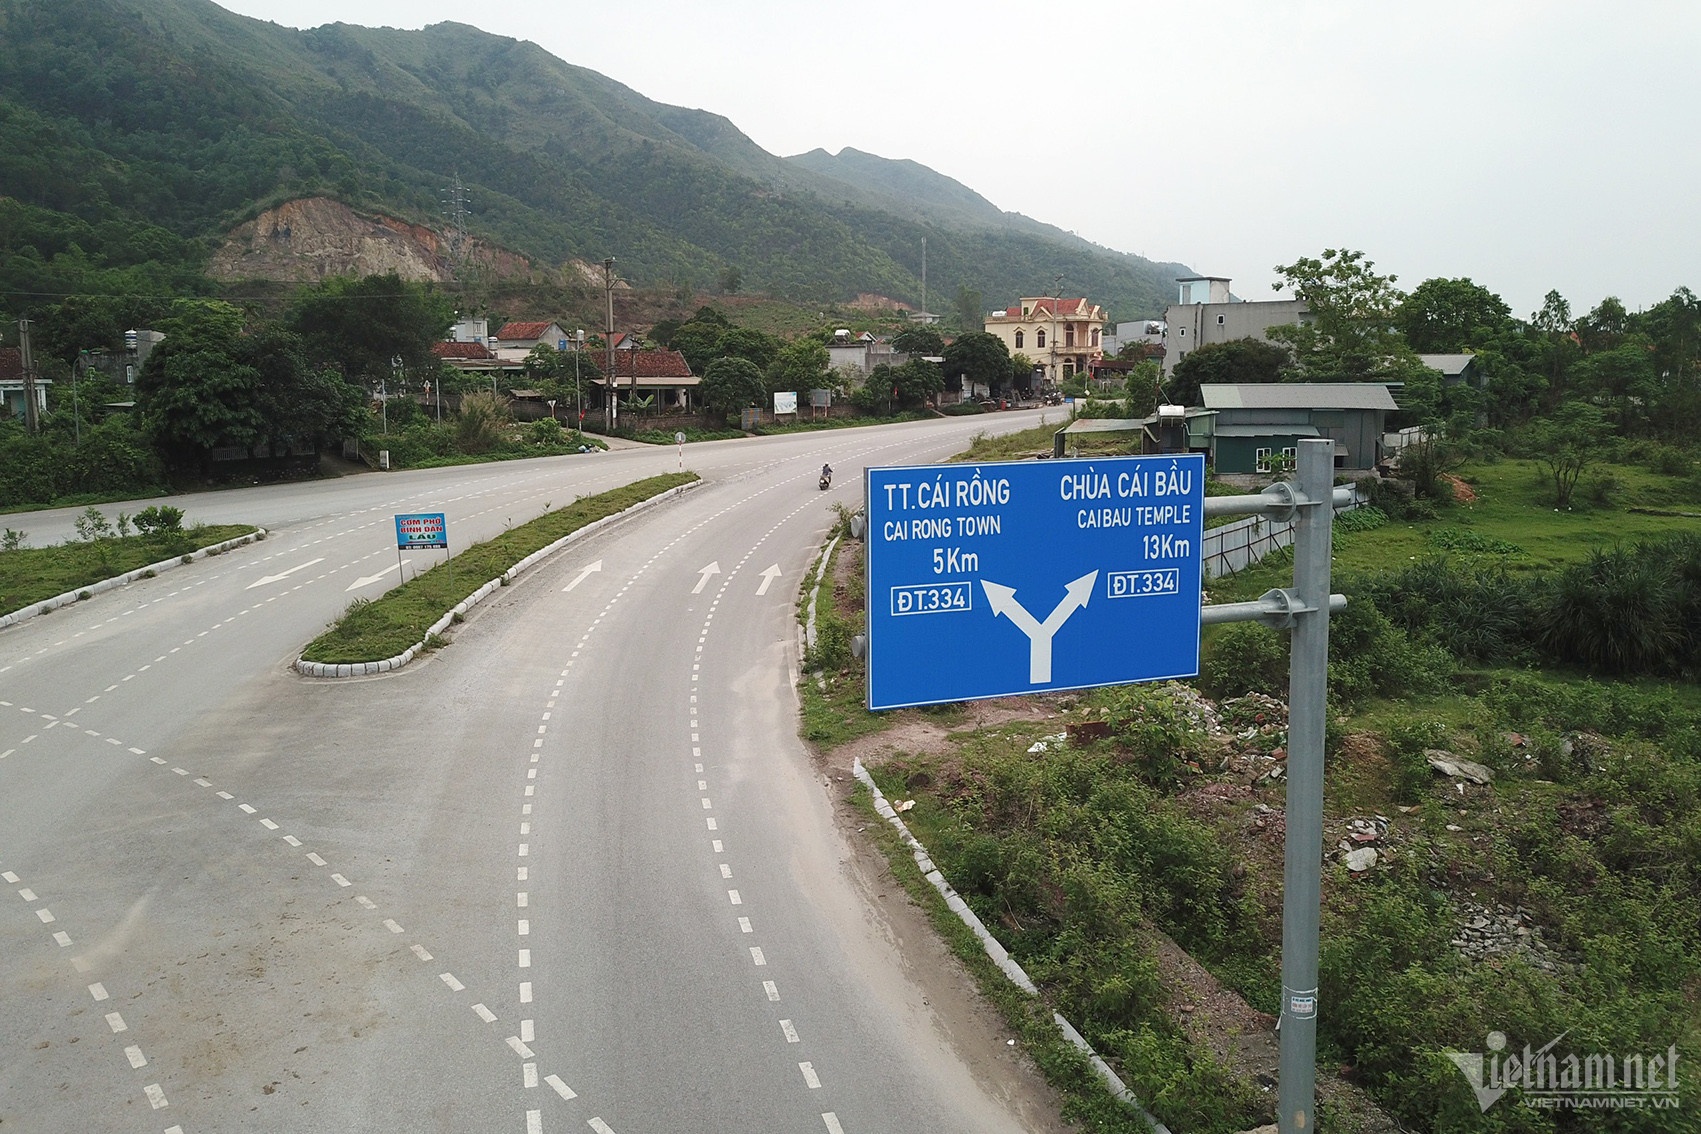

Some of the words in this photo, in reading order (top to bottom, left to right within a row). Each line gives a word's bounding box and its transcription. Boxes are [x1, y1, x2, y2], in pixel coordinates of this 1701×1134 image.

[956, 468, 1010, 506] RỒNG
[1060, 467, 1110, 500] CHÙA
[1117, 465, 1148, 497] CÁI
[1155, 460, 1192, 496] BẦU
[884, 520, 907, 541] CAI
[912, 517, 951, 539] RONG
[957, 515, 1001, 536] TOWN
[1136, 505, 1191, 525] TEMPLE
[1143, 533, 1190, 560] 13Km
[1112, 572, 1175, 595] ĐT.334
[897, 588, 966, 612] ĐT.334
